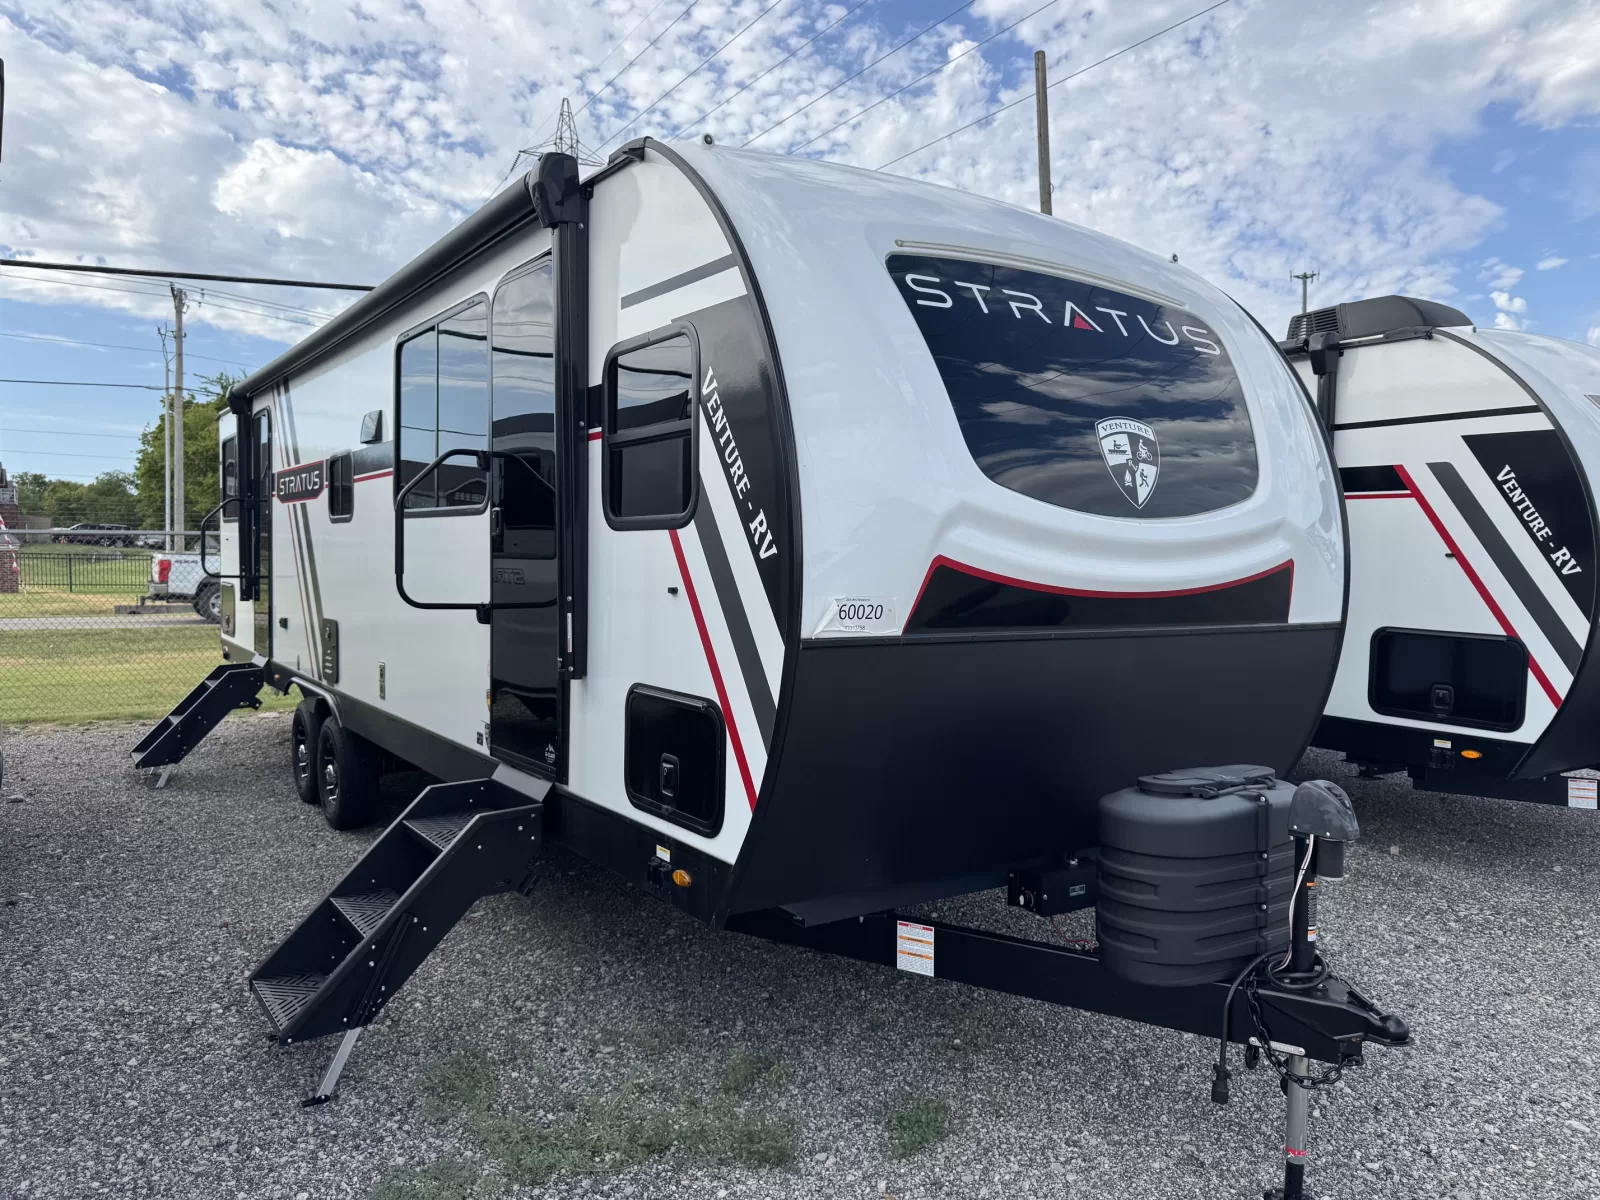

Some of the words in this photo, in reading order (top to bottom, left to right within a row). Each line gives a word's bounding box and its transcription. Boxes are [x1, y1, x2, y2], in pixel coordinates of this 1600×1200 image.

[905, 273, 1221, 355] STRATUS
[702, 366, 750, 500] VENTURE
[750, 509, 778, 560] RV
[1101, 422, 1151, 437] VENTURE
[279, 470, 320, 496] STRATUS
[1496, 464, 1552, 542] VENTURE
[1550, 546, 1582, 575] RV
